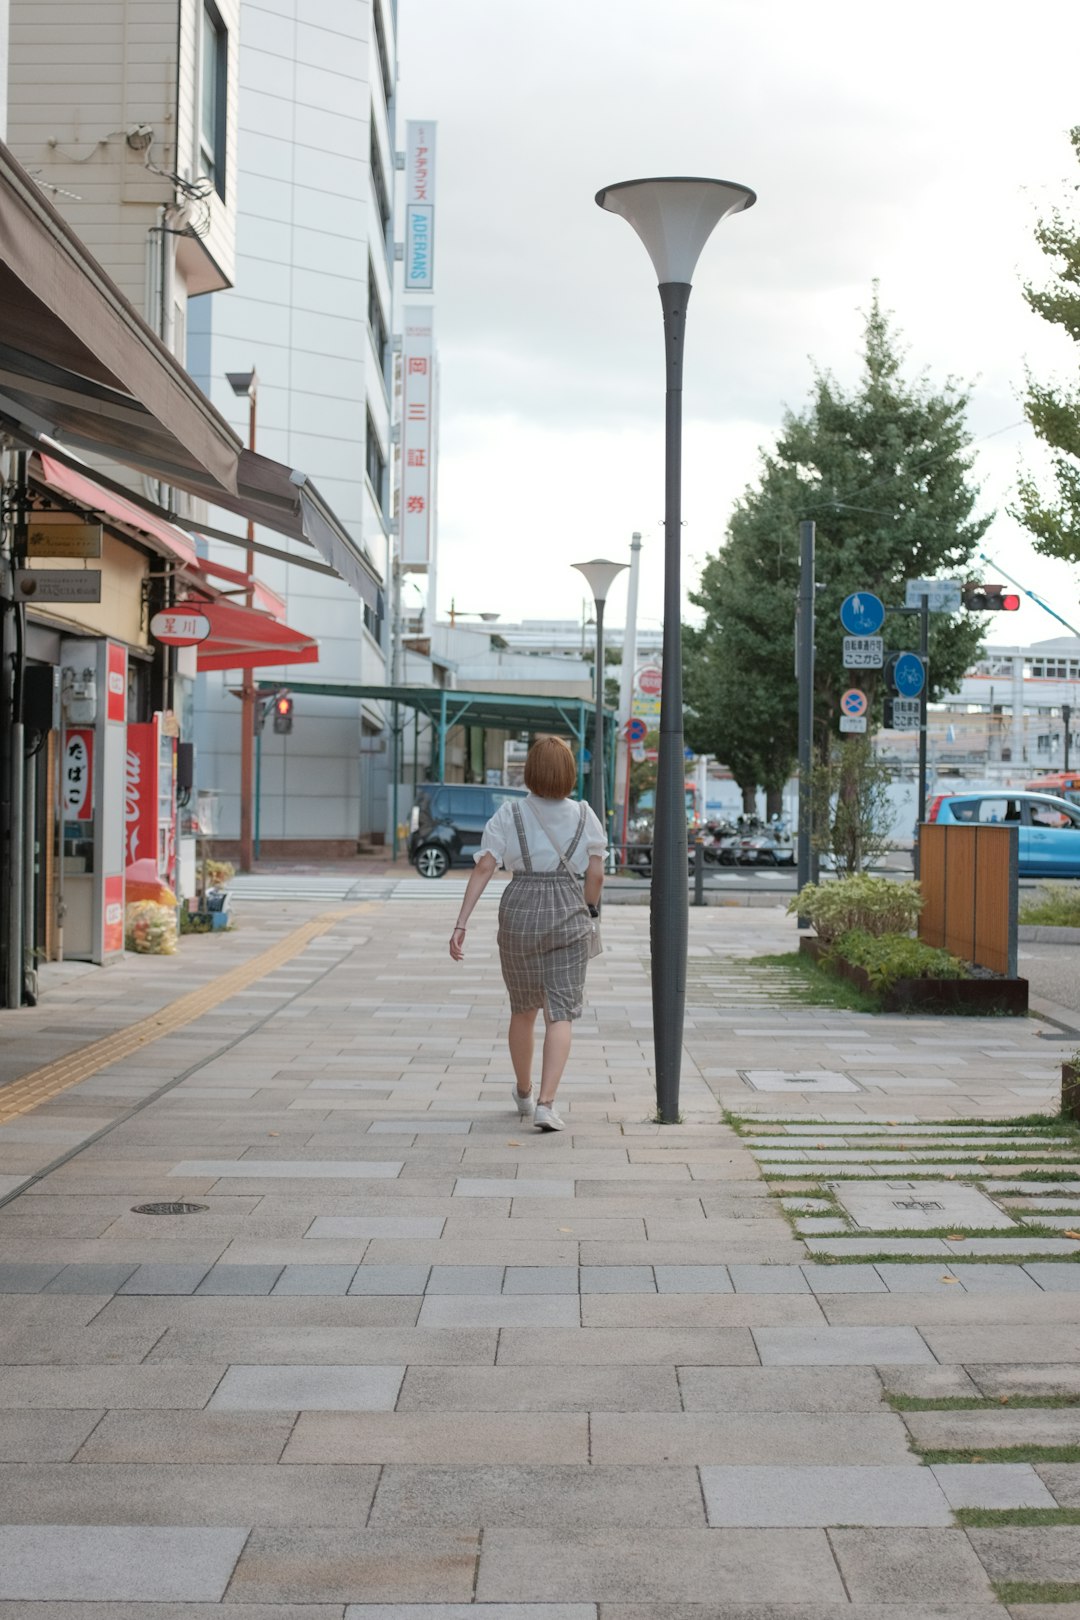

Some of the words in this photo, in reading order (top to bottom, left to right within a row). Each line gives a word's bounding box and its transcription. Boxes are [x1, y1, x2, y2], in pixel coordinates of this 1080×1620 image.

[411, 213, 428, 279] ADERANS
[407, 358, 427, 513] 岡三証券
[162, 618, 197, 635] 星川
[845, 640, 882, 651] 自転車通行可
[845, 655, 882, 665] ここから
[894, 716, 919, 726] ここまで
[68, 743, 86, 804] たばこ
